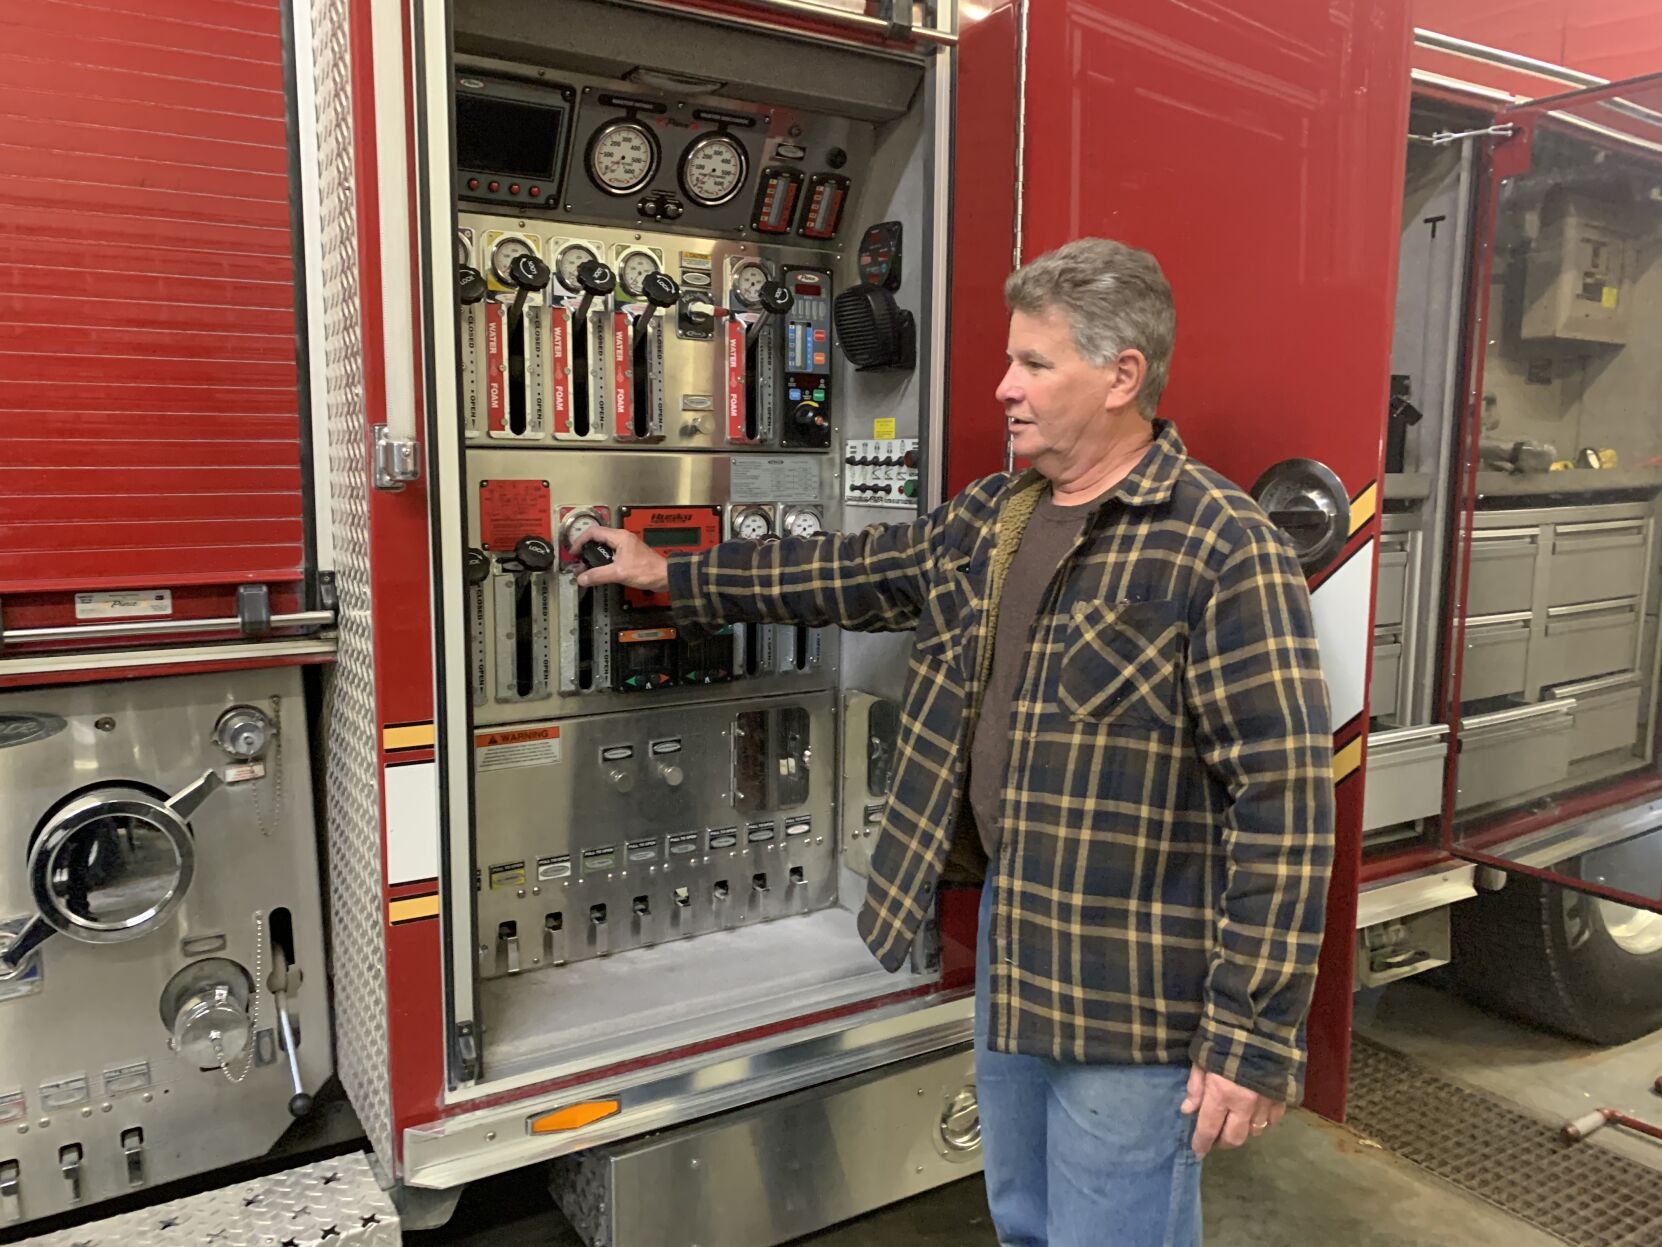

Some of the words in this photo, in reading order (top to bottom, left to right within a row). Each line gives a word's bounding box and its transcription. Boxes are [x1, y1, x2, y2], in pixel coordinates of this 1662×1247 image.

[656, 278, 672, 292] LOCK
[488, 322, 497, 354] WATER
[554, 327, 562, 358] WATER
[490, 383, 498, 408] FOAM
[651, 514, 692, 522] Husky
[528, 544, 546, 556] LOCK
[597, 546, 611, 560] LOCK
[500, 729, 549, 742] WARNING
